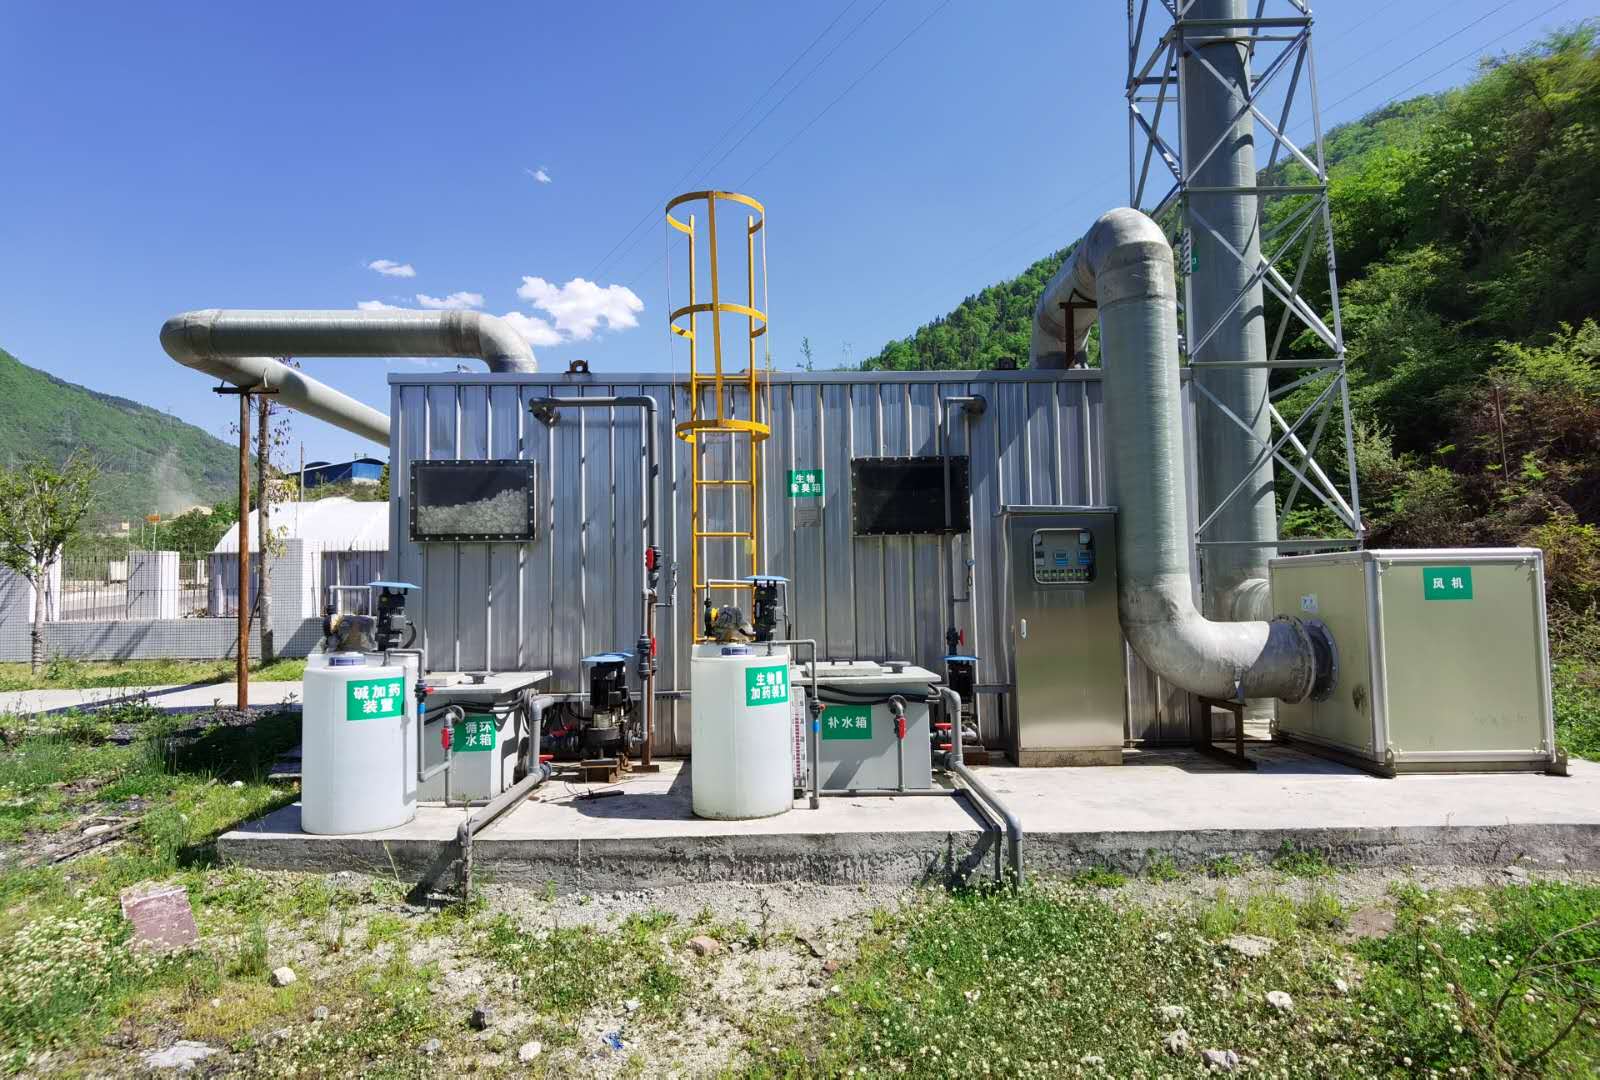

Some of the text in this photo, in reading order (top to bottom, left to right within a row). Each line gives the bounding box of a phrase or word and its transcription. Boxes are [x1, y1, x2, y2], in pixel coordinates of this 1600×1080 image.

[796, 473, 815, 484] 生物
[1432, 577, 1464, 590] 风机
[353, 683, 400, 700] 碱加药
[363, 698, 394, 713] 装置
[465, 721, 492, 734] 循环
[828, 716, 867, 729] 补水箱
[465, 734, 492, 747] 水箱
